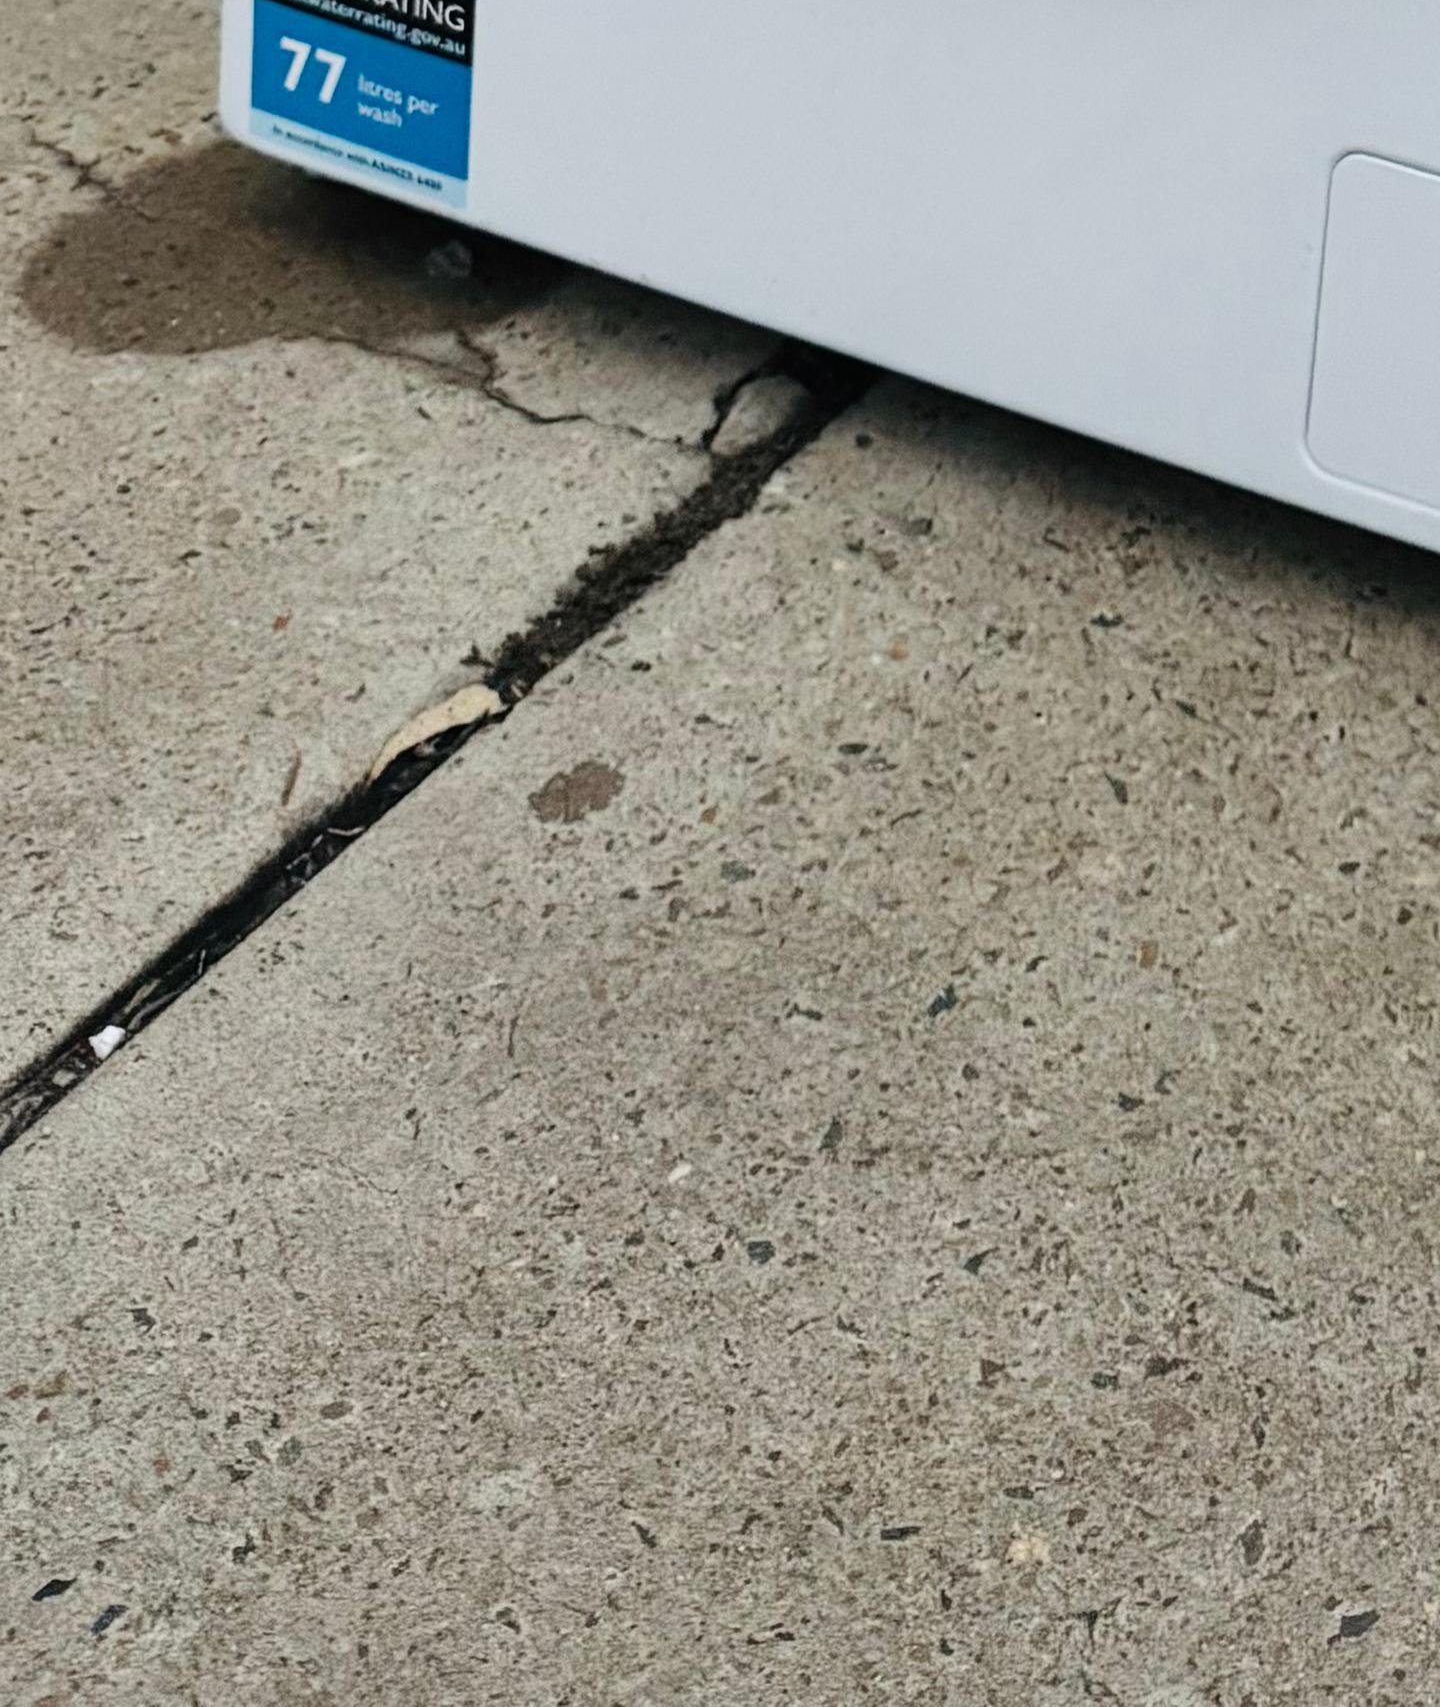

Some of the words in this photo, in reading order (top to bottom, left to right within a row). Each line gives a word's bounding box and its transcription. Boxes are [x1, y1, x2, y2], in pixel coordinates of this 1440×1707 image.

[279, 35, 347, 105] 77
[357, 103, 402, 127] wash
[358, 73, 402, 104] litres
[407, 94, 439, 116] per
